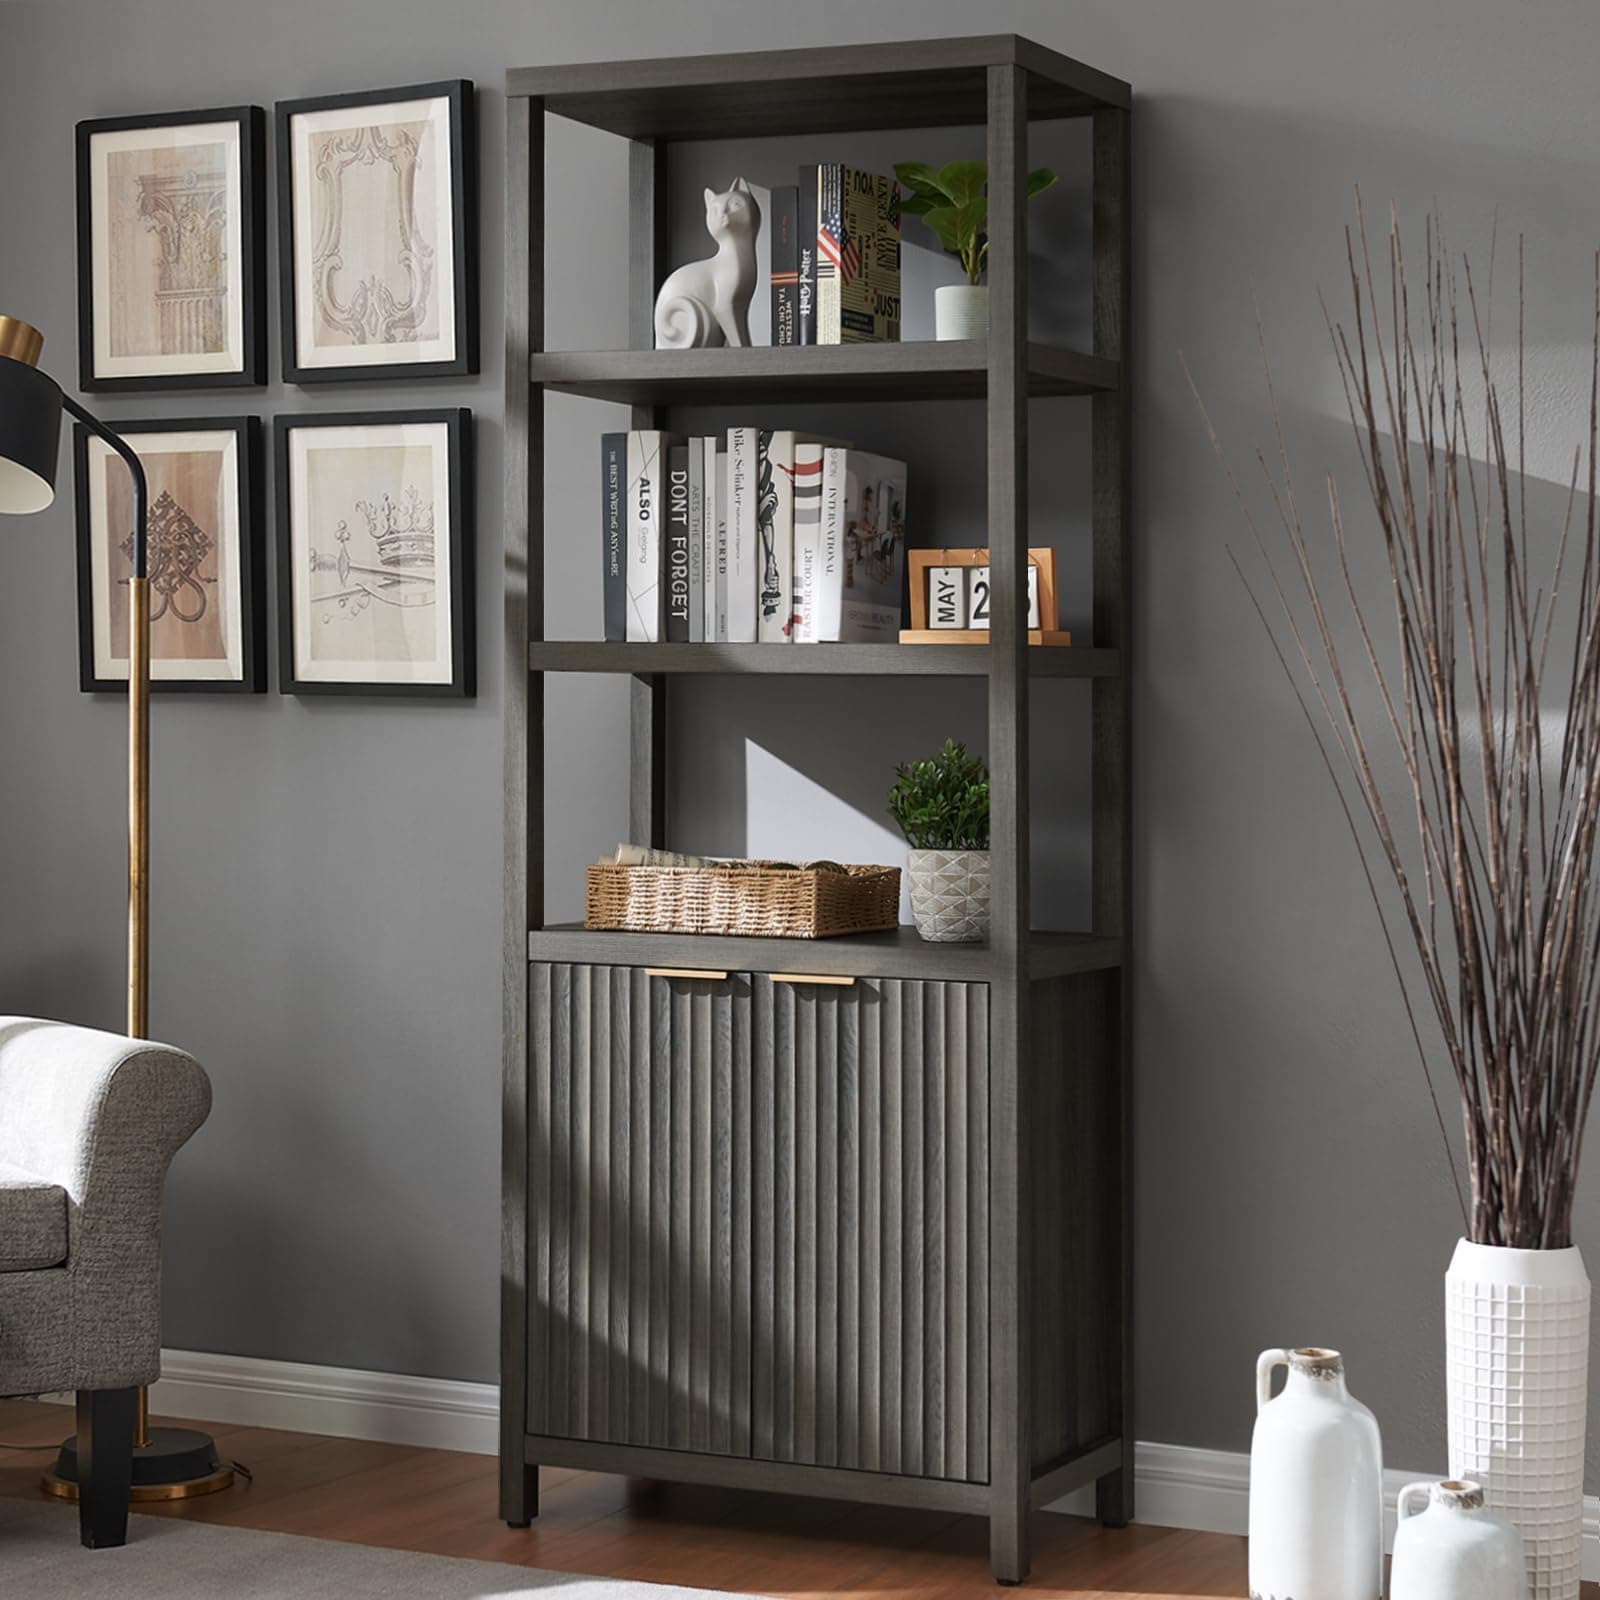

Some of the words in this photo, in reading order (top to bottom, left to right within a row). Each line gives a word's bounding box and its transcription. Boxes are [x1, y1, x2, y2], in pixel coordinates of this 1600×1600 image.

[854, 170, 874, 196] YOU
[800, 248, 814, 284] Potter
[778, 287, 786, 303] TAI
[800, 283, 812, 315] Harry
[874, 294, 900, 320] JUST
[778, 305, 786, 322] CHI
[785, 300, 793, 344] WESTERN
[778, 324, 786, 346] CHU
[734, 428, 744, 456] Mike
[610, 464, 618, 489] BEST
[639, 478, 650, 521] ALSO
[671, 471, 687, 526] DONT
[692, 486, 700, 513] ARTS
[692, 518, 700, 539] THE
[826, 488, 837, 576] INTERNATIONAL
[671, 536, 688, 621] FORGET
[692, 543, 700, 585] CRAFTS
[803, 548, 813, 587] COURT
[938, 580, 955, 622] MAY
[973, 581, 990, 620] 2
